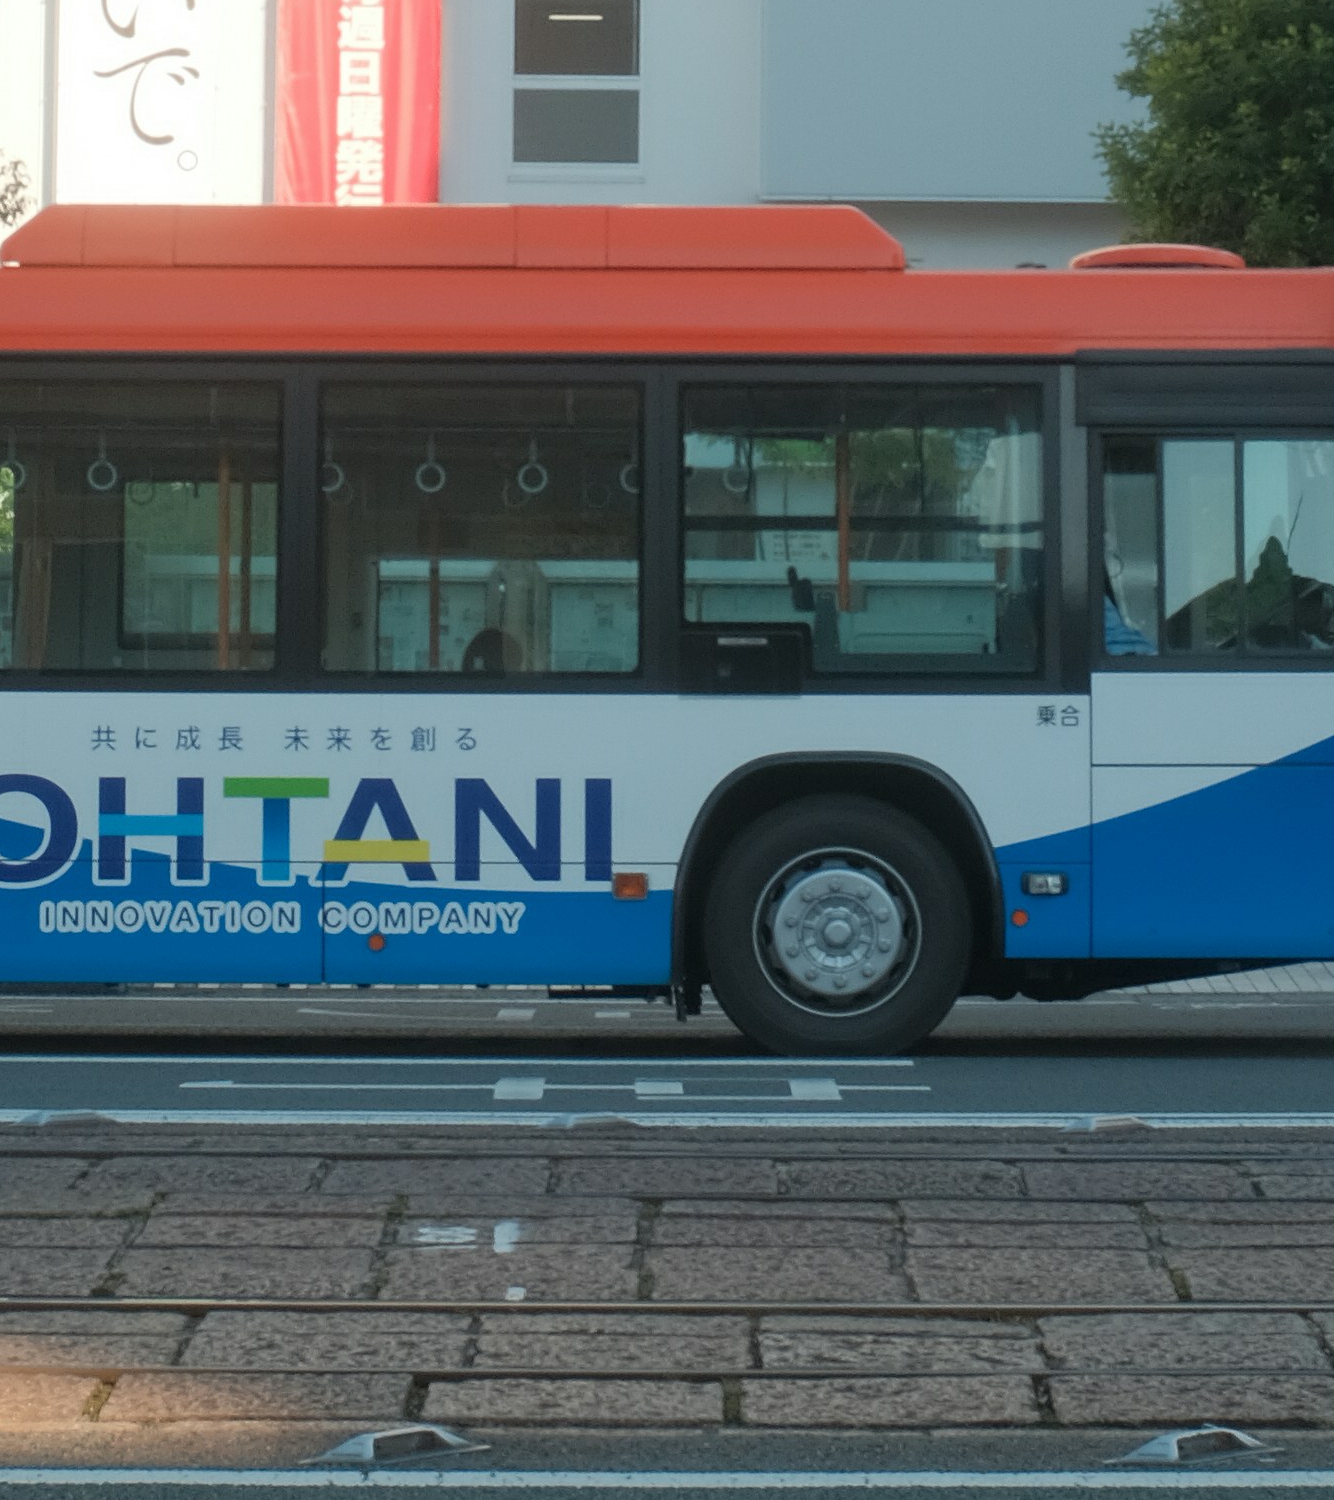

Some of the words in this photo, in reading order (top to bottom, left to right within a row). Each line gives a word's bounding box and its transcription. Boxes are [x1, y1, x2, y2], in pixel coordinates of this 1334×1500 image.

[1035, 704, 1081, 728] 乗合
[90, 725, 245, 753] 共に成長
[284, 725, 479, 753] 未来を創る
[40, 901, 301, 933] INNOVATION
[319, 901, 526, 933] COMPANY
